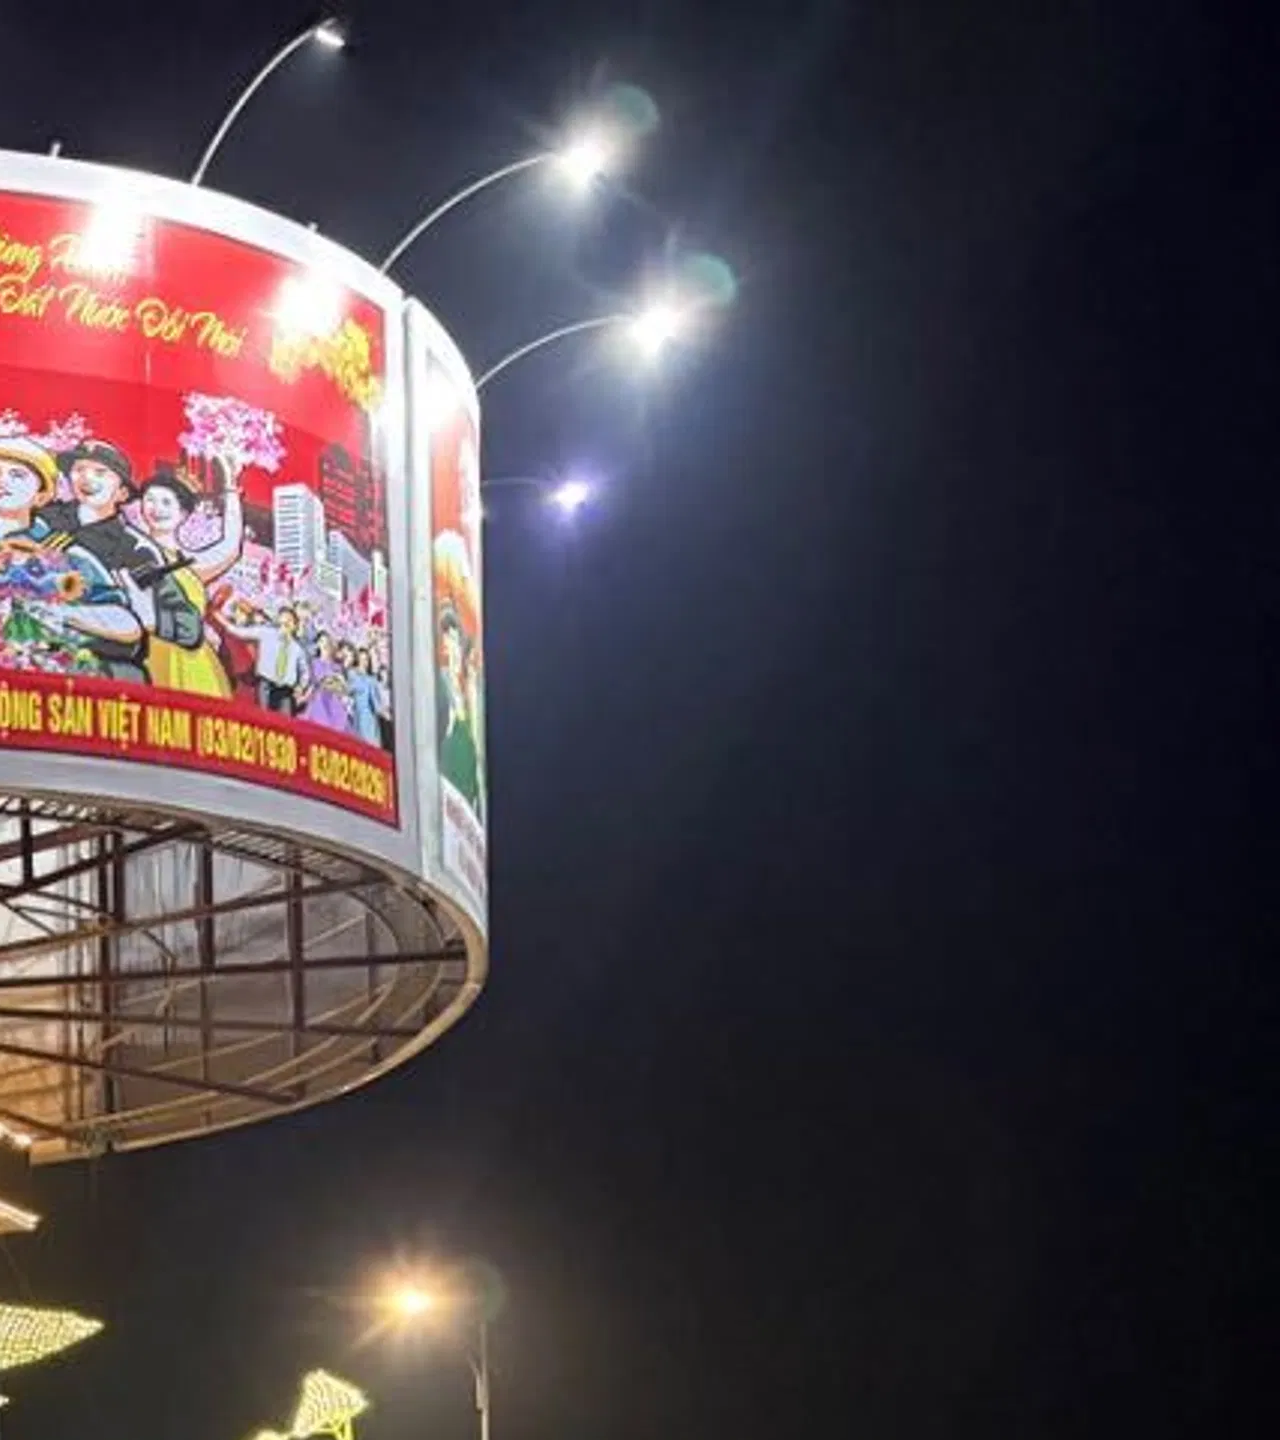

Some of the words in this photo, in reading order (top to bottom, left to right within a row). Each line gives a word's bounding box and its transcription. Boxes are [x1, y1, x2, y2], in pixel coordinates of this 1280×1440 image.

[47, 678, 93, 738] SẢN
[97, 692, 141, 750] VIỆT
[145, 704, 192, 751] NAM
